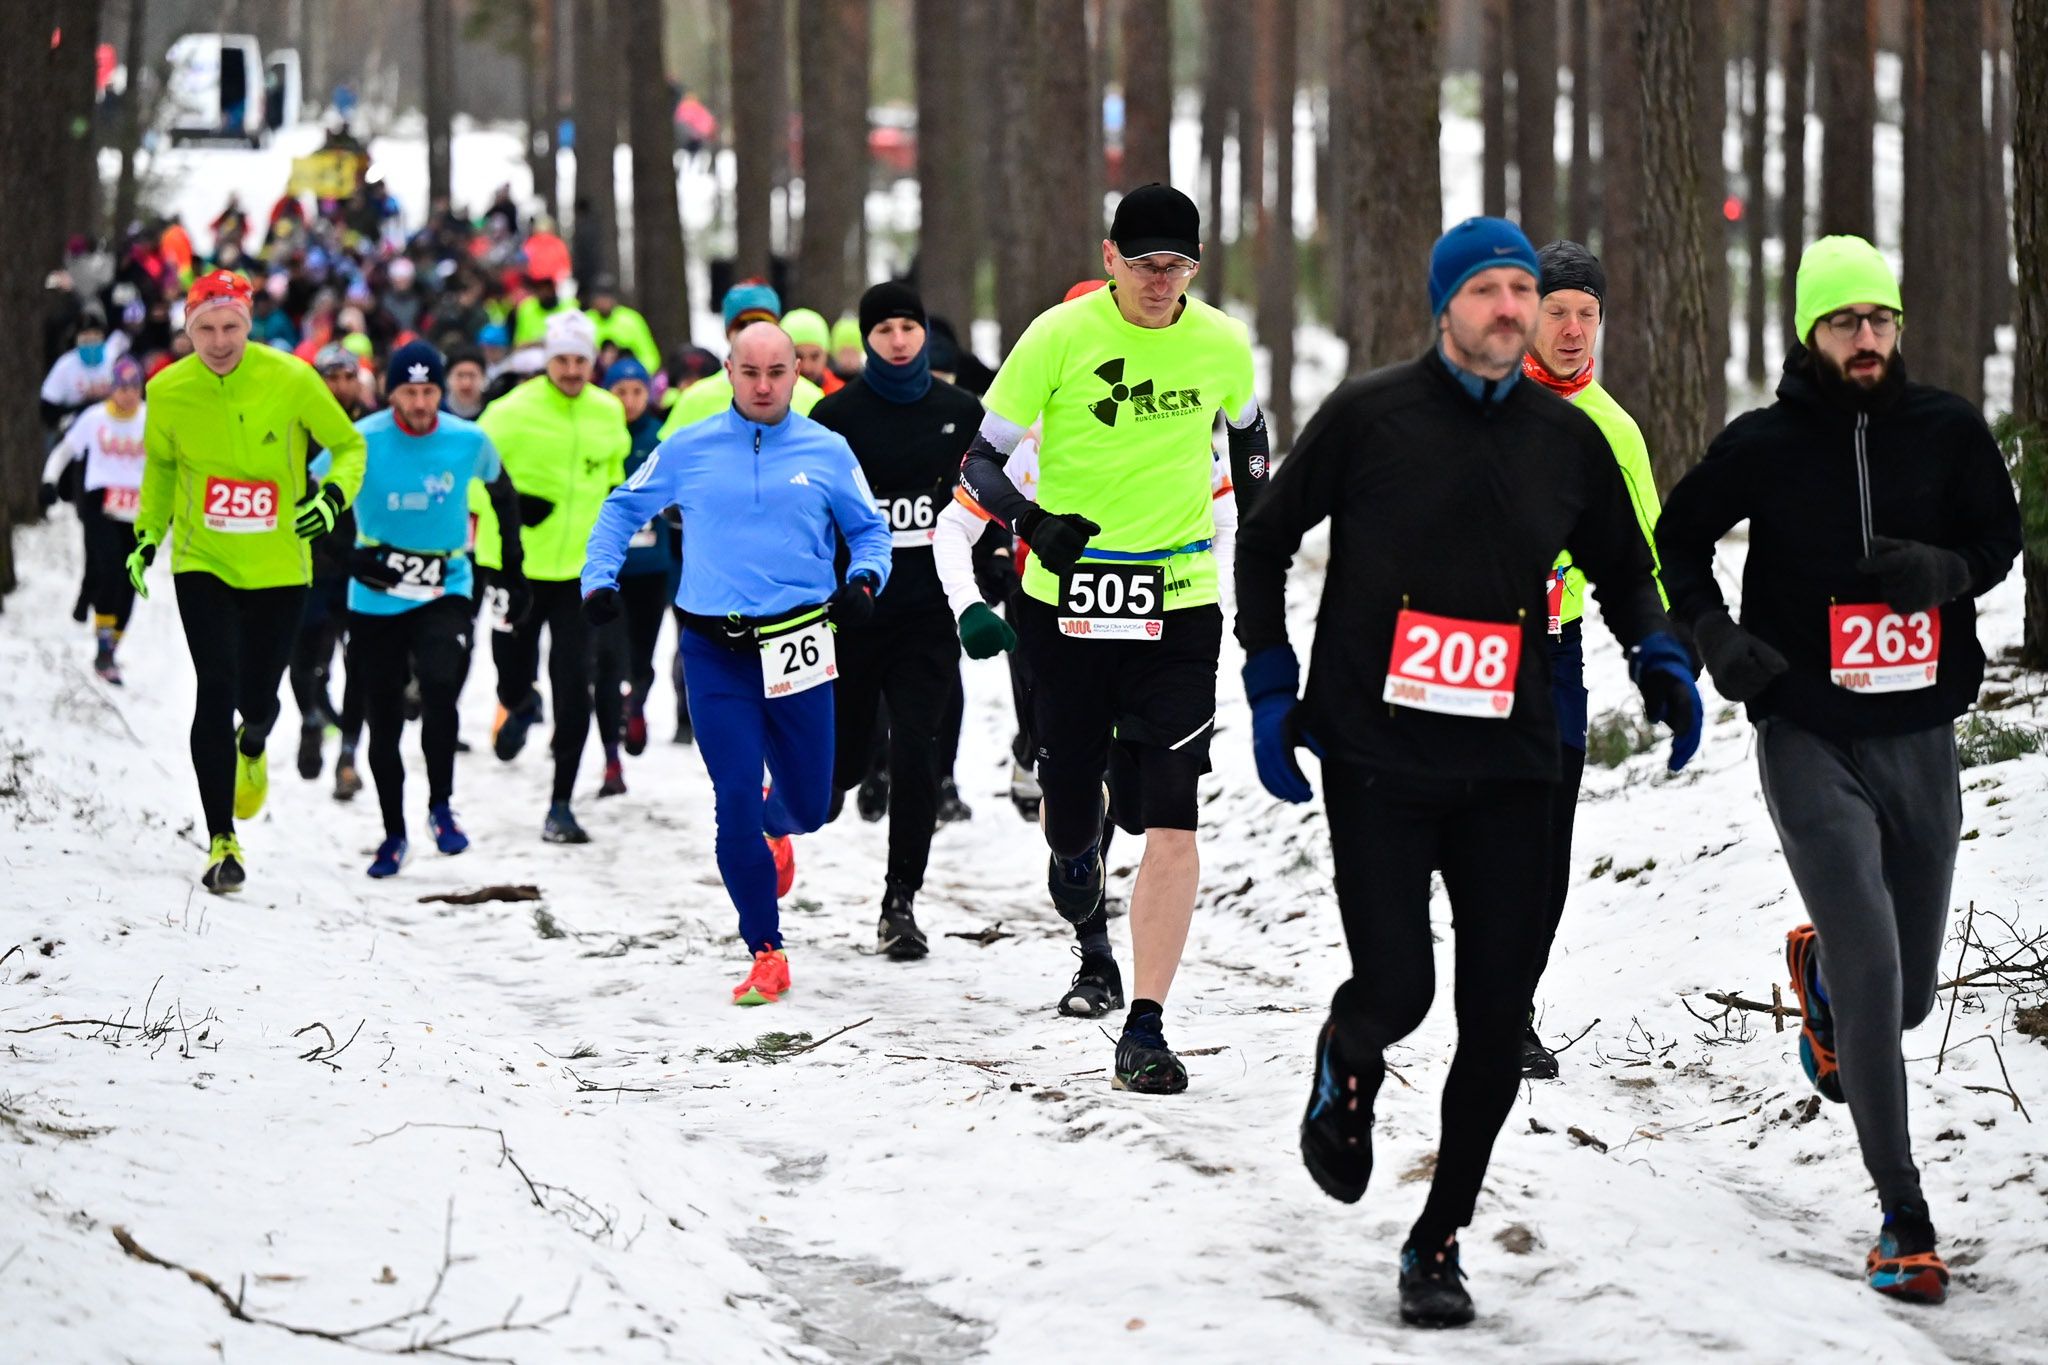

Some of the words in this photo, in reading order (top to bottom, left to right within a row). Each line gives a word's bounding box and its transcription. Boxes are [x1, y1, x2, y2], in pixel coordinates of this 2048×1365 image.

[1133, 389, 1201, 415] RCR
[1134, 411, 1169, 423] RUNCROSS
[1171, 406, 1203, 417] ROZGARTY
[208, 483, 273, 517] 256
[877, 495, 934, 529] 506
[386, 552, 441, 585] 524
[1067, 573, 1155, 615] 505
[1841, 611, 1933, 664] 263
[780, 635, 820, 675] 26
[1400, 624, 1509, 688] 208
